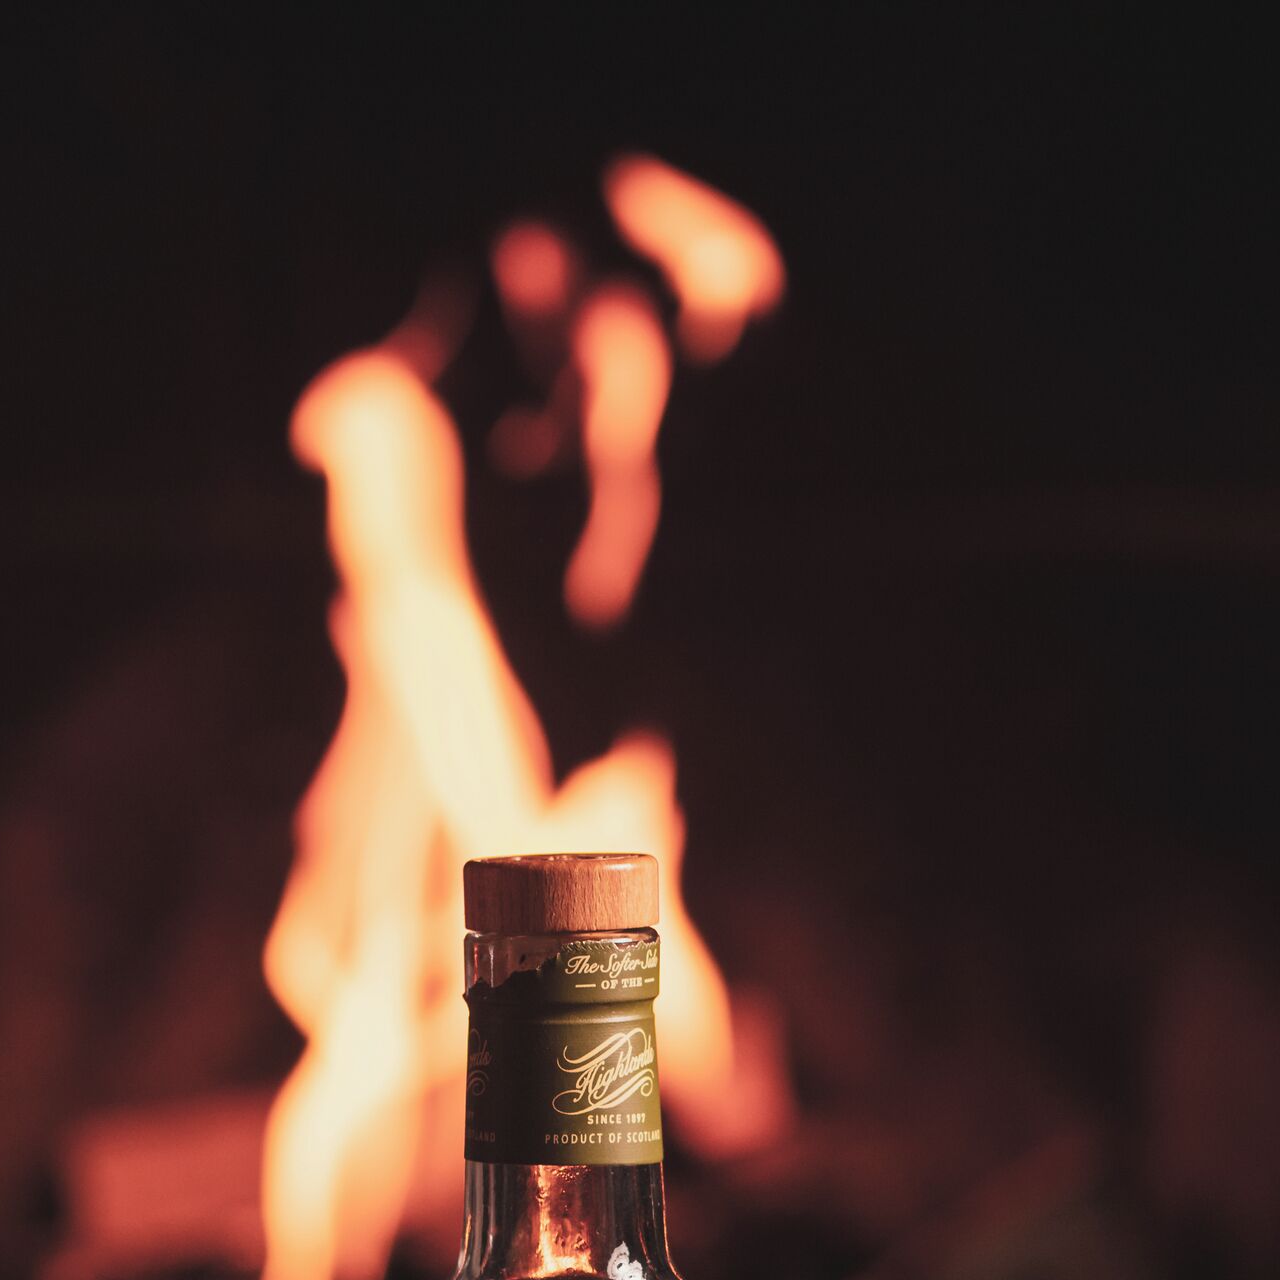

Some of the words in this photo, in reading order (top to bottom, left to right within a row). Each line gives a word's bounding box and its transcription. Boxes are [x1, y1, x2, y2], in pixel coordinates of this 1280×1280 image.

[564, 954, 600, 974] The
[600, 952, 640, 978] Softer
[600, 980, 618, 990] OF
[622, 977, 642, 988] THE
[586, 1114, 622, 1124] SINCE
[626, 1112, 646, 1124] 1897
[544, 1132, 603, 1144] PRODUCT
[608, 1132, 622, 1144] OF
